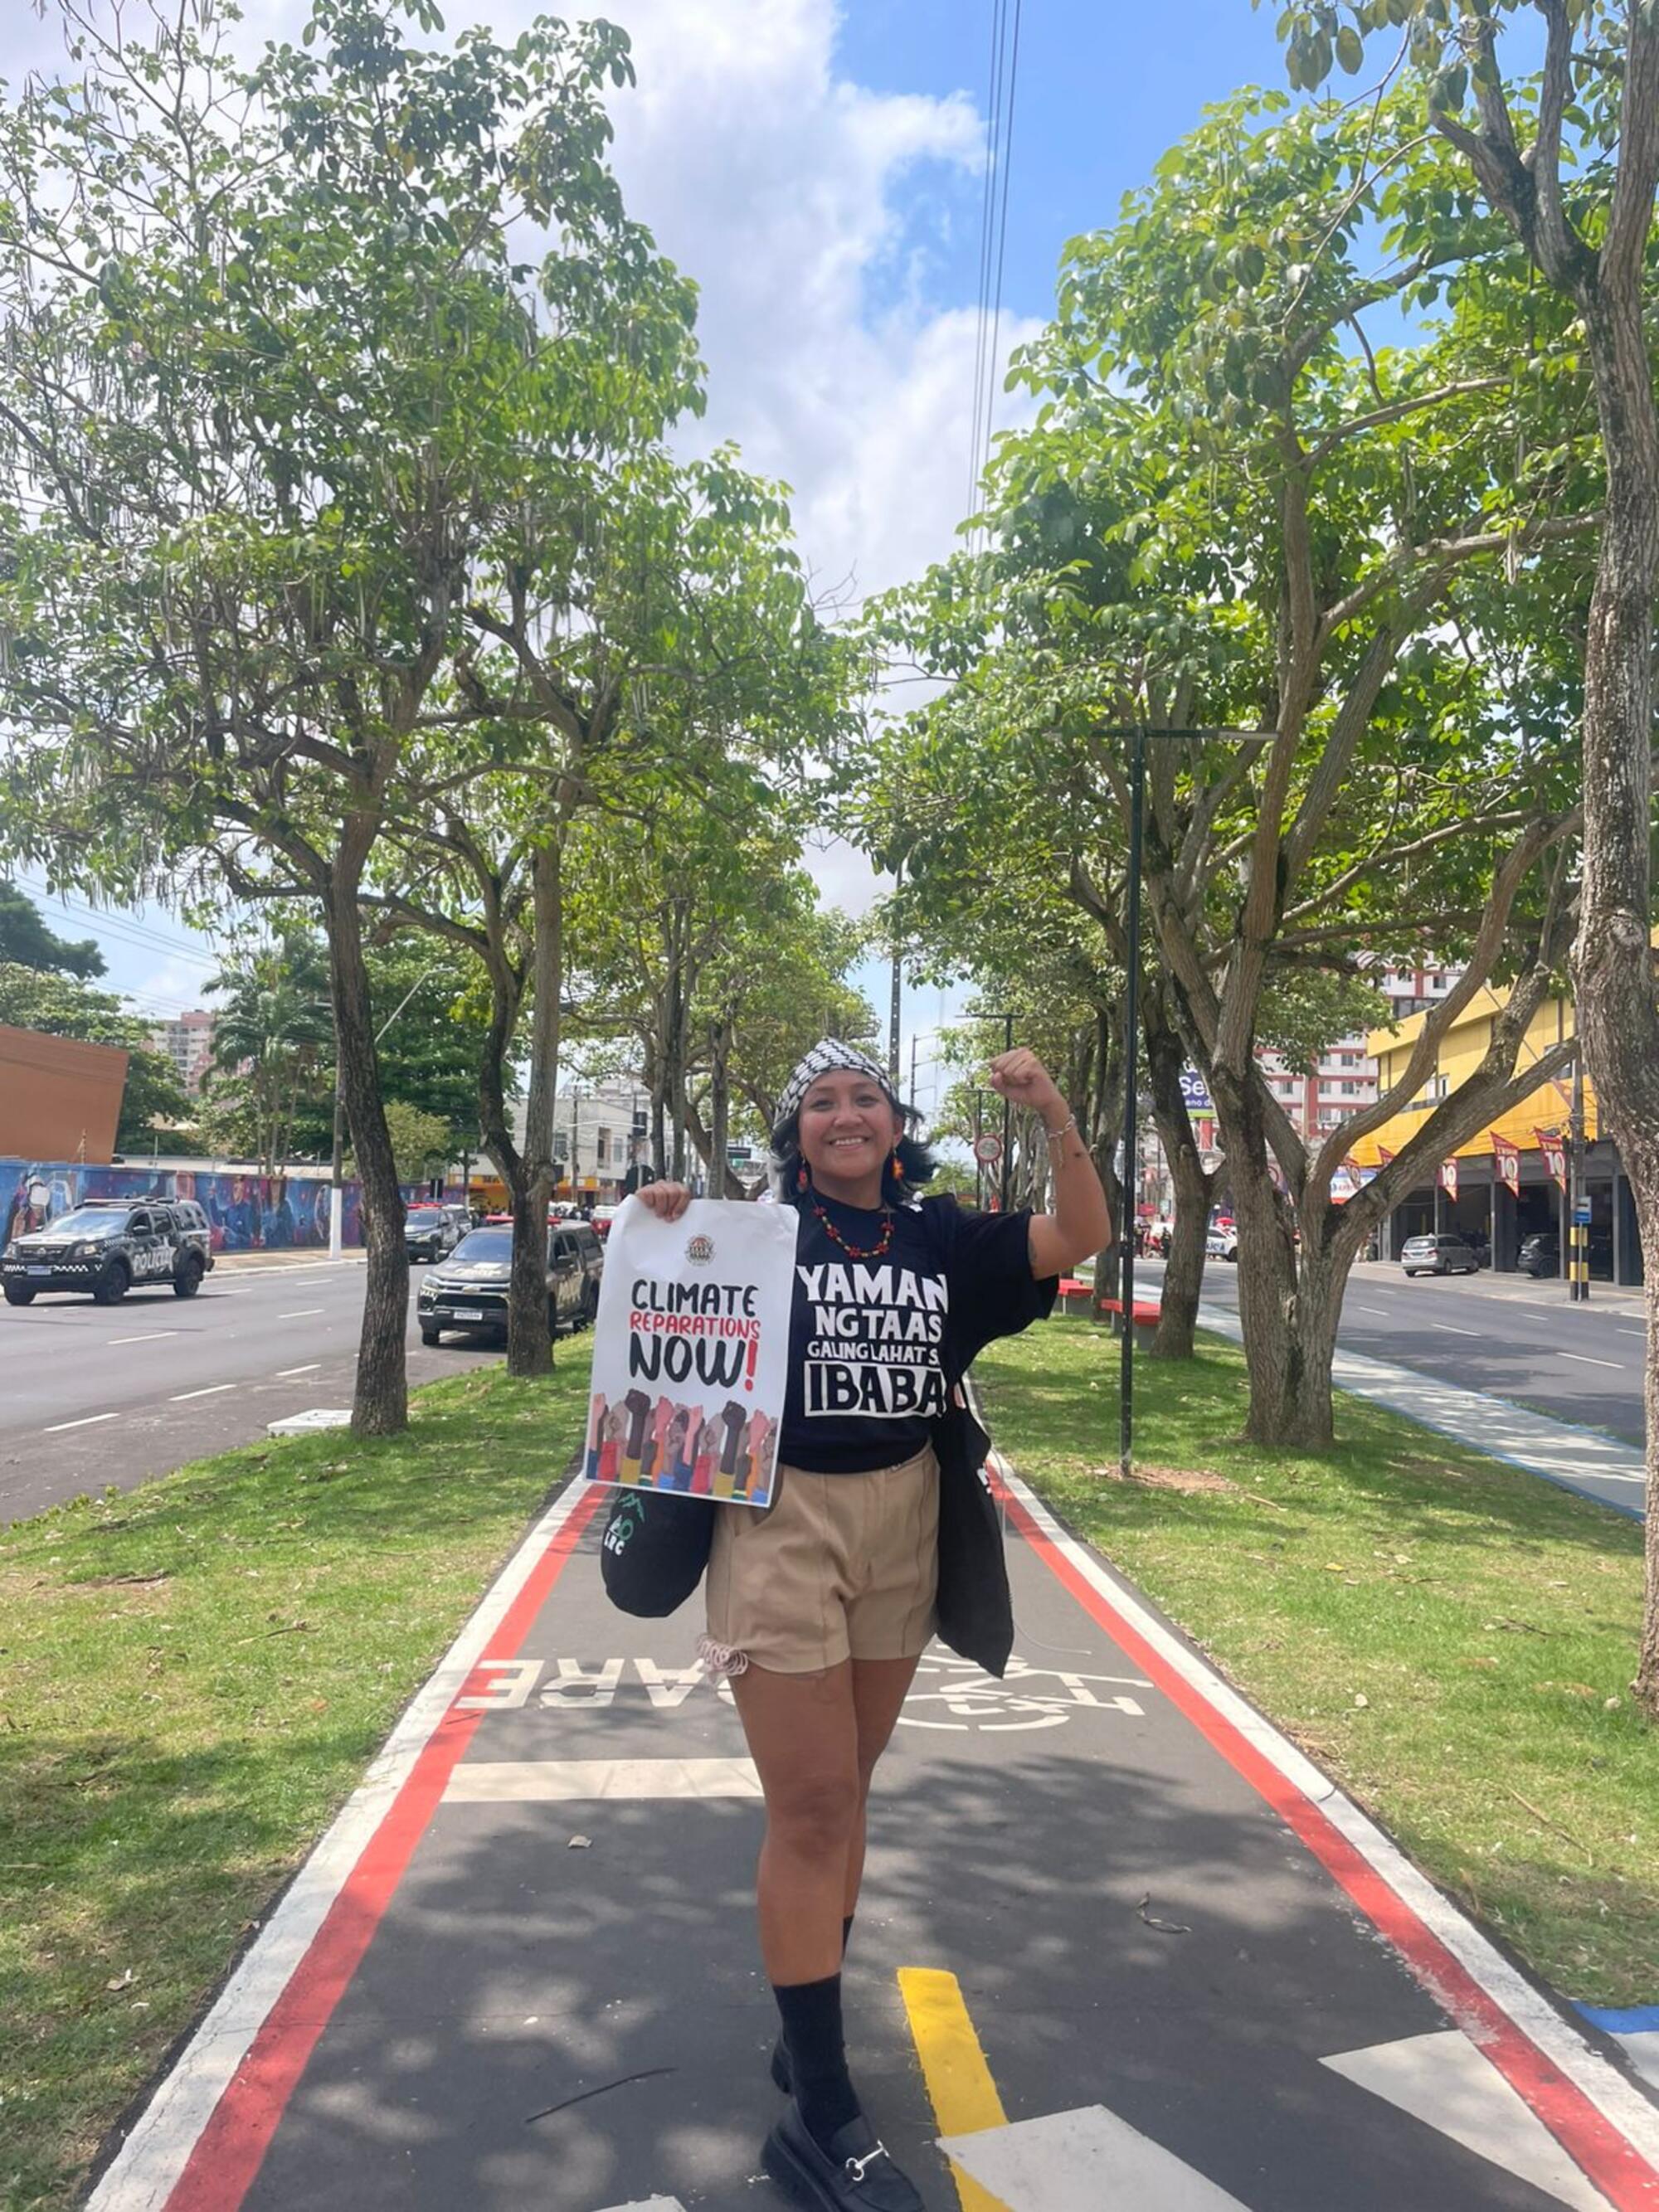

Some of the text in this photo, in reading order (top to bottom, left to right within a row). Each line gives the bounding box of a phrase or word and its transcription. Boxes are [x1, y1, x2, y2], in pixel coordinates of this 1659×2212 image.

[1179, 1076, 1208, 1096] Se
[1497, 1155, 1518, 1179] 10
[1545, 1151, 1566, 1176] 10
[631, 1279, 759, 1317] CLIMATE
[796, 1263, 949, 1314] YAMAN
[630, 1311, 761, 1340] REPARATIONS
[815, 1305, 942, 1344] NG TAAS
[630, 1331, 758, 1392] NOW!
[807, 1341, 941, 1365] GALING LAHAT S
[809, 1363, 944, 1414] IBABA
